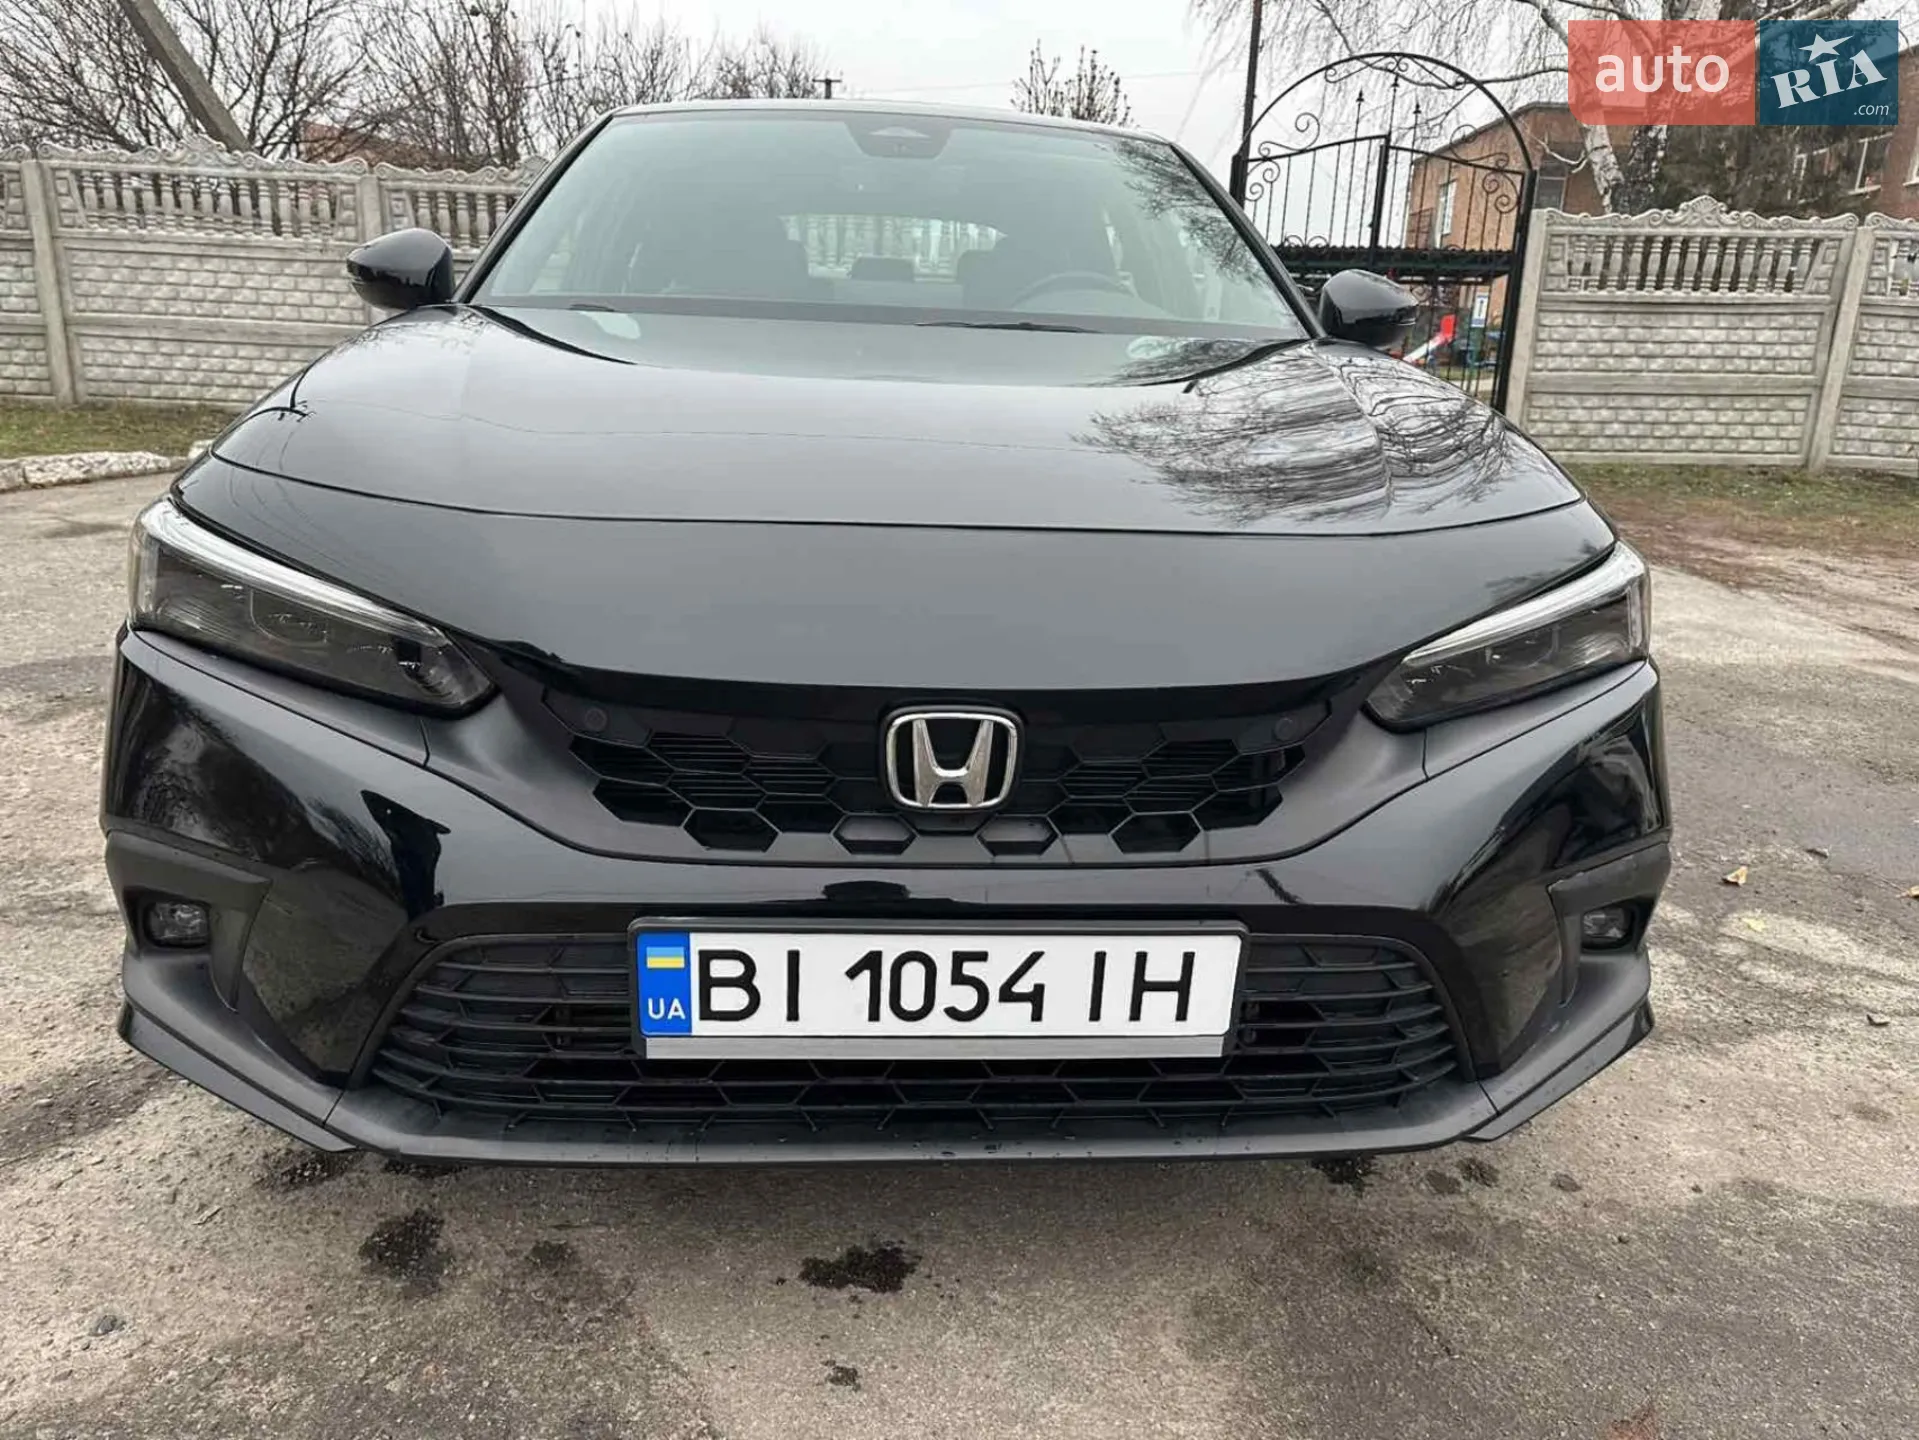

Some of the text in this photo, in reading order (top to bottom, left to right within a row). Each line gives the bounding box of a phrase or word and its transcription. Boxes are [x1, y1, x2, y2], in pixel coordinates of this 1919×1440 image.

[647, 998, 687, 1020] UA
[698, 949, 1196, 1023] BI 1054 IH
